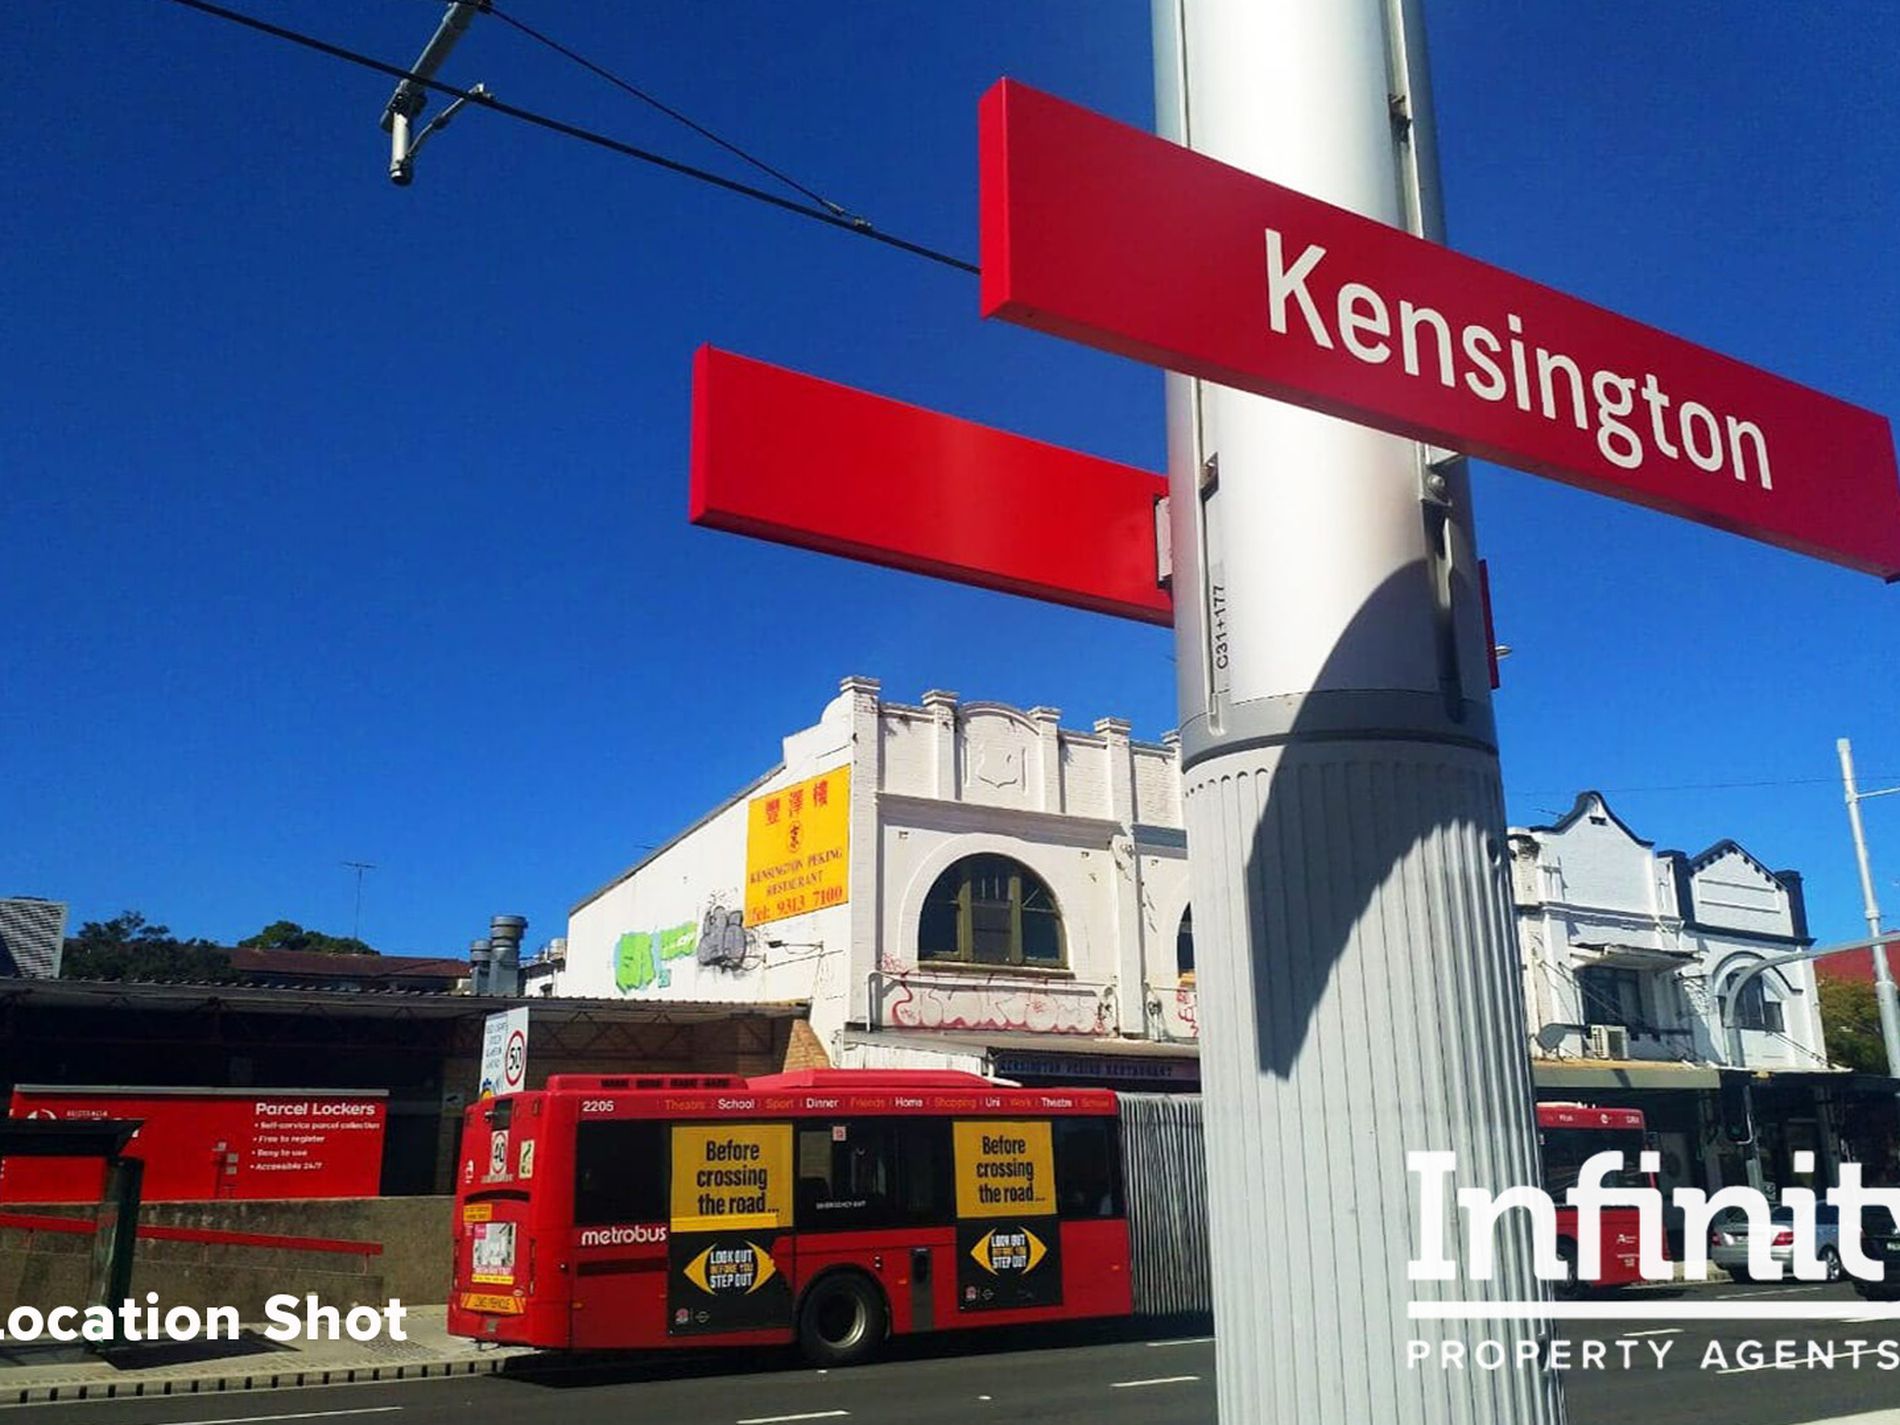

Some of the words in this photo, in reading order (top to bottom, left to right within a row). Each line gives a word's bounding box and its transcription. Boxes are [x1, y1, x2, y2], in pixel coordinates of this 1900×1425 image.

[1265, 228, 1773, 491] Kensington
[1213, 586, 1228, 669] C31+177
[750, 860, 804, 884] KENSINGTON
[808, 849, 842, 868] PEKING
[766, 870, 823, 896] RESTAURANT
[777, 895, 805, 915] 9313
[813, 886, 842, 907] 7100
[508, 1046, 522, 1070] 50
[255, 1102, 309, 1116] Parcel
[312, 1102, 375, 1115] Lockers
[583, 1100, 615, 1112] 2205
[718, 1098, 755, 1110] School
[806, 1097, 838, 1109] Dinner
[895, 1096, 923, 1108] Home
[985, 1096, 1001, 1107] Uni
[258, 1135, 278, 1143] Free
[281, 1135, 289, 1143] to
[982, 1134, 1026, 1155] Before
[706, 1139, 760, 1162] Before
[696, 1165, 768, 1191] crossing
[976, 1157, 1034, 1181] crossing
[698, 1193, 725, 1215] the
[979, 1183, 1001, 1204] the
[581, 1225, 667, 1246] metrobus
[710, 1250, 734, 1264] LOOK
[735, 1249, 753, 1263] OUT
[710, 1274, 734, 1288] STEP
[735, 1273, 753, 1287] OUT
